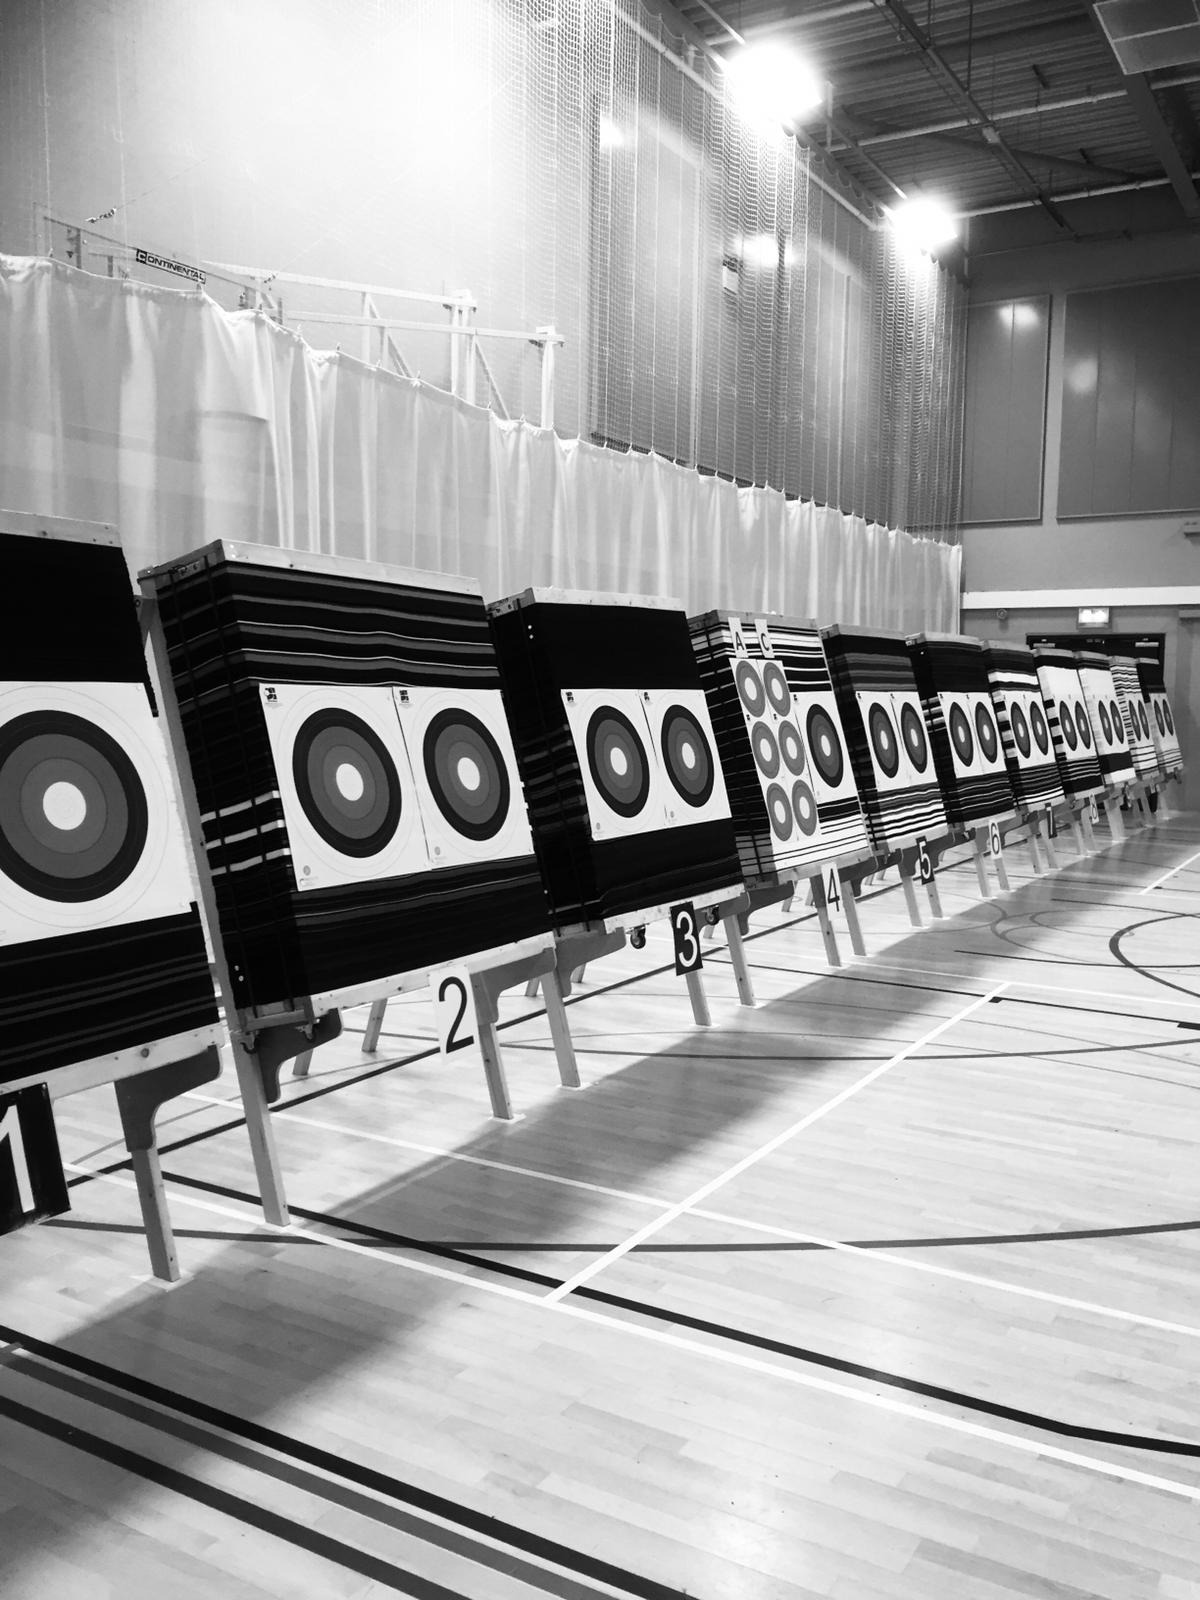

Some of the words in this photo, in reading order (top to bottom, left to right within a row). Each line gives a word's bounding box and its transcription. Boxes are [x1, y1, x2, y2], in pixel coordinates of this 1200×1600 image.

[137, 250, 204, 280] CONTINENTAL
[735, 631, 745, 651] A
[760, 632, 770, 651] C
[990, 822, 1000, 855] 6
[919, 840, 931, 879] 5
[828, 868, 840, 912] 4
[676, 911, 698, 967] 3
[438, 976, 475, 1053] 2
[0, 1104, 36, 1214] 1
